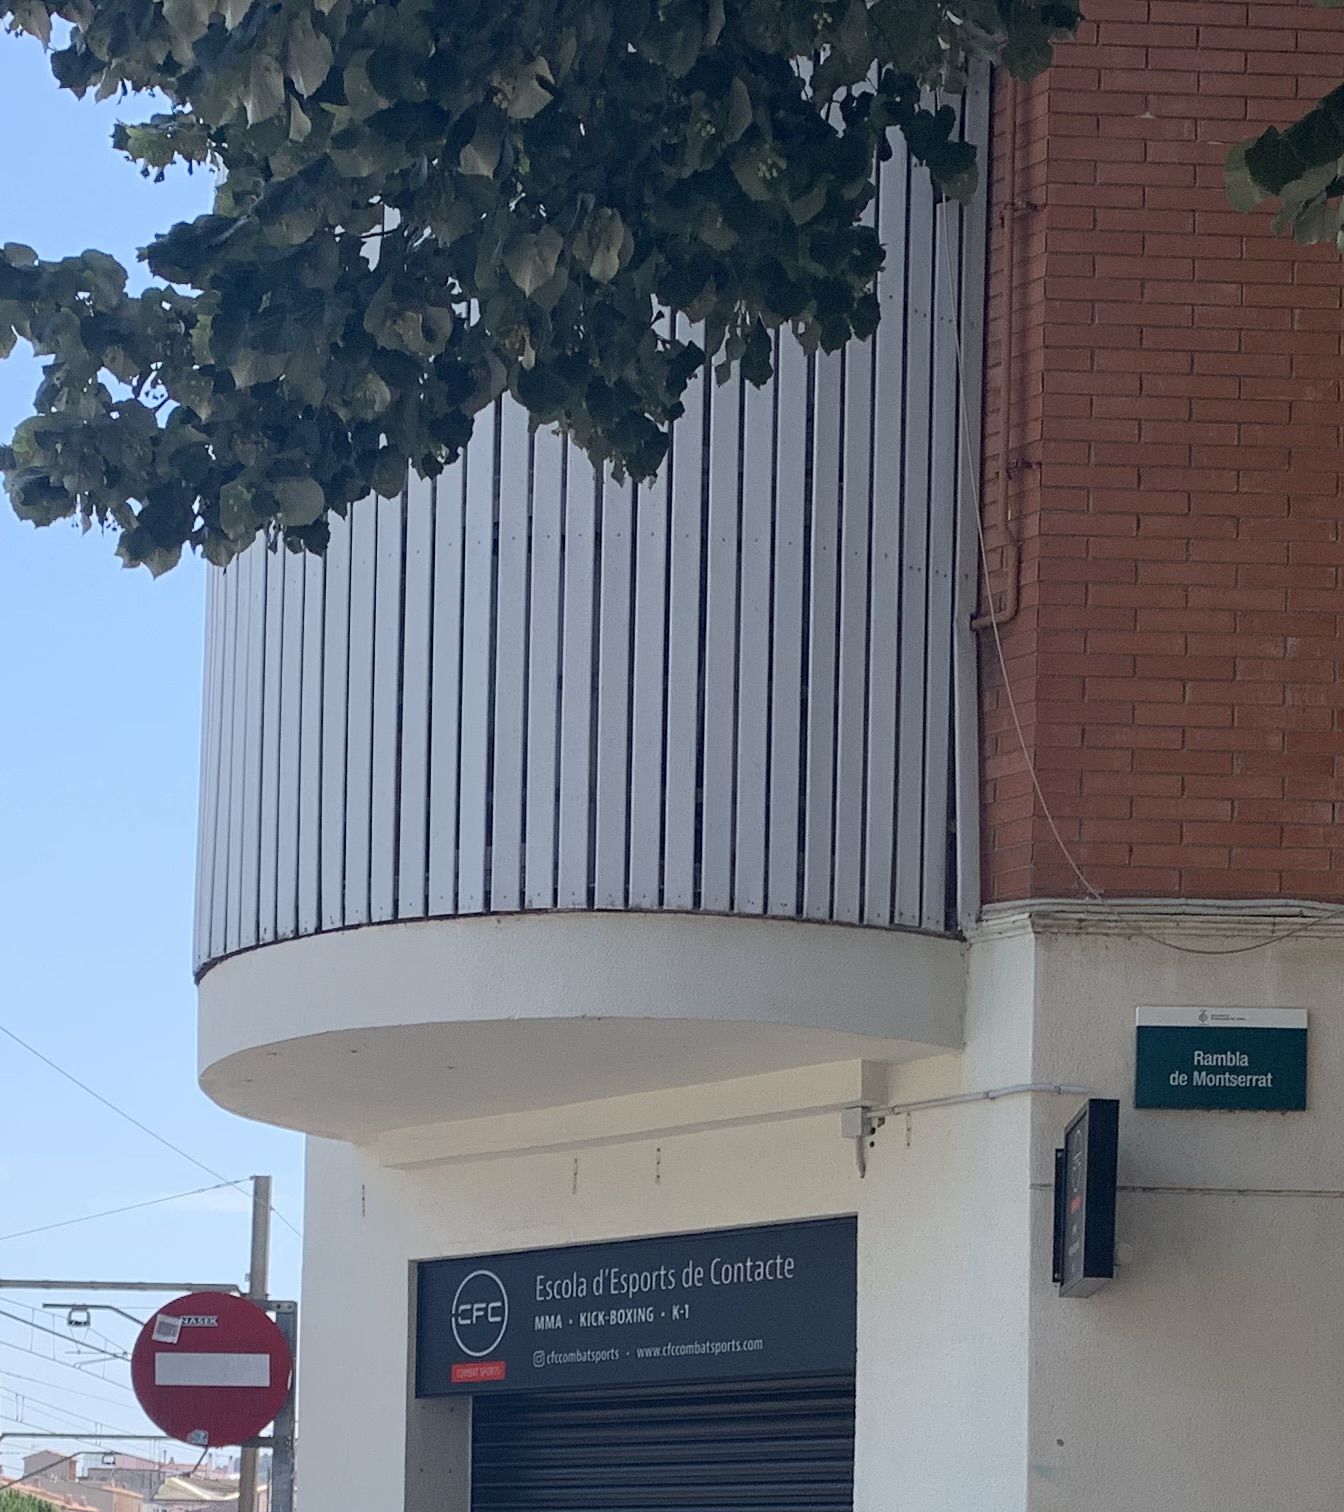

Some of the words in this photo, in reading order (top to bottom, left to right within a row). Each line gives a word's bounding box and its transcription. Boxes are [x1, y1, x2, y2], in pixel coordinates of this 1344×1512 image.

[1193, 1050, 1249, 1067] Rambla
[1169, 1070, 1188, 1086] de
[1192, 1070, 1273, 1088] Montserrat
[535, 1271, 587, 1301] Escola
[592, 1265, 676, 1299] d'Esports
[682, 1260, 704, 1288] de
[710, 1254, 795, 1286] Contacte
[457, 1302, 502, 1325] CFC
[534, 1314, 563, 1331] MMA
[579, 1306, 654, 1328] KICK-BOXING
[671, 1304, 690, 1321] K-1
[546, 1348, 620, 1367] cfccombatsports
[636, 1338, 764, 1359] www.cfccombatsports.com
